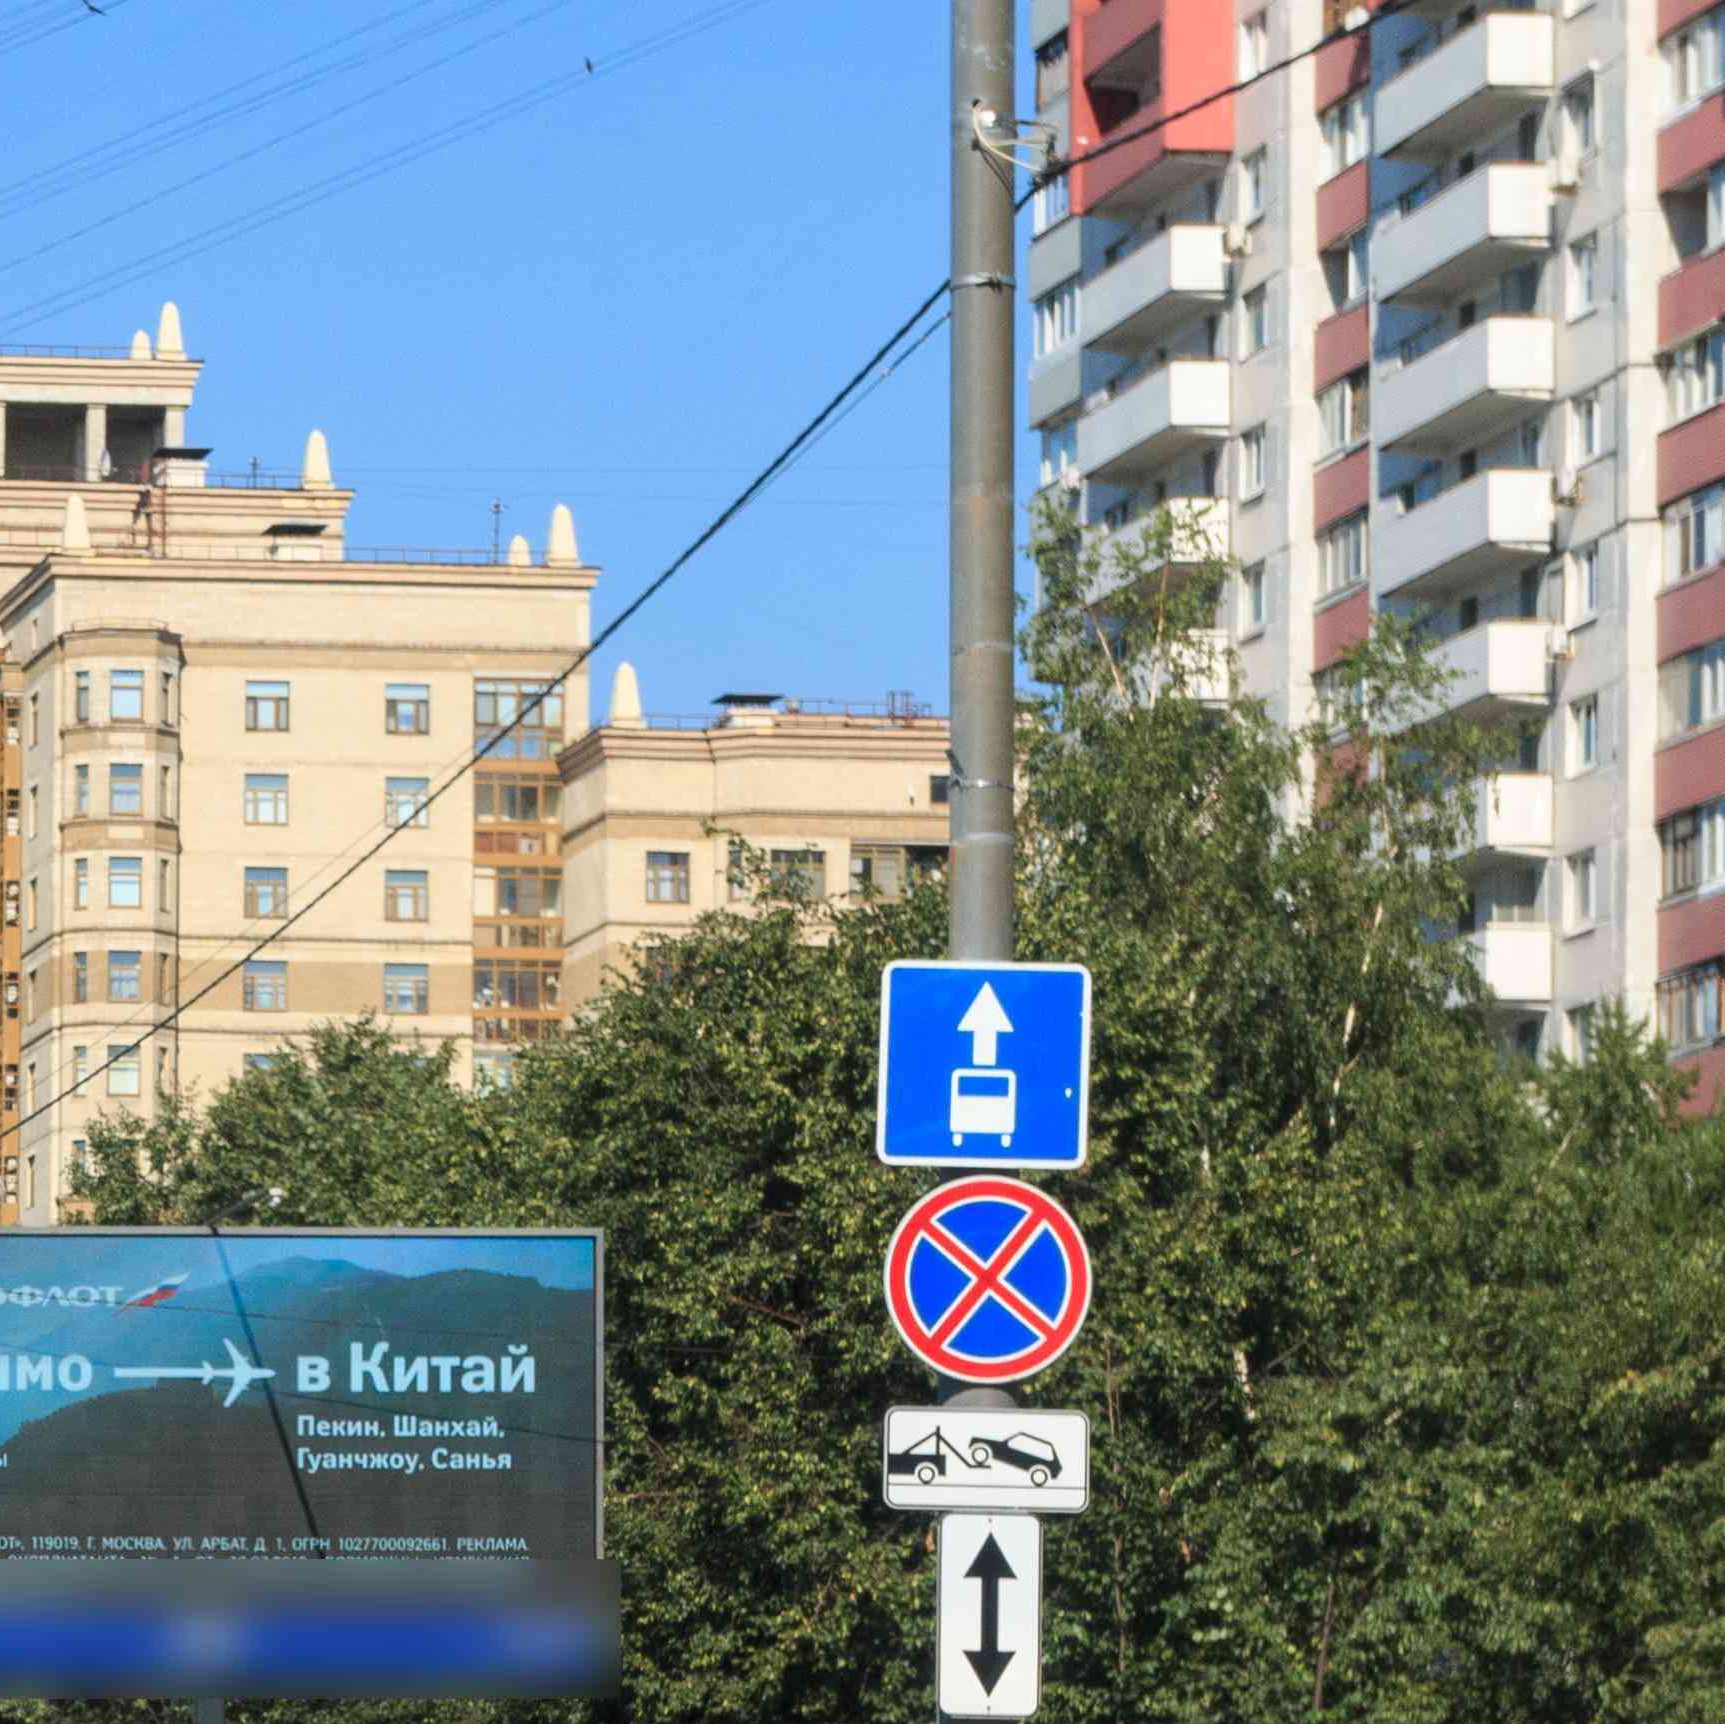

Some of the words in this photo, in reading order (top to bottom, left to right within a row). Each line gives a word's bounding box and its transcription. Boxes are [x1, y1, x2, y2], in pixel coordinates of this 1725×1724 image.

[296, 1355, 331, 1393] в
[350, 1341, 536, 1393] Китай
[431, 1447, 512, 1470] Санья
[291, 1536, 331, 1550] ОГРН
